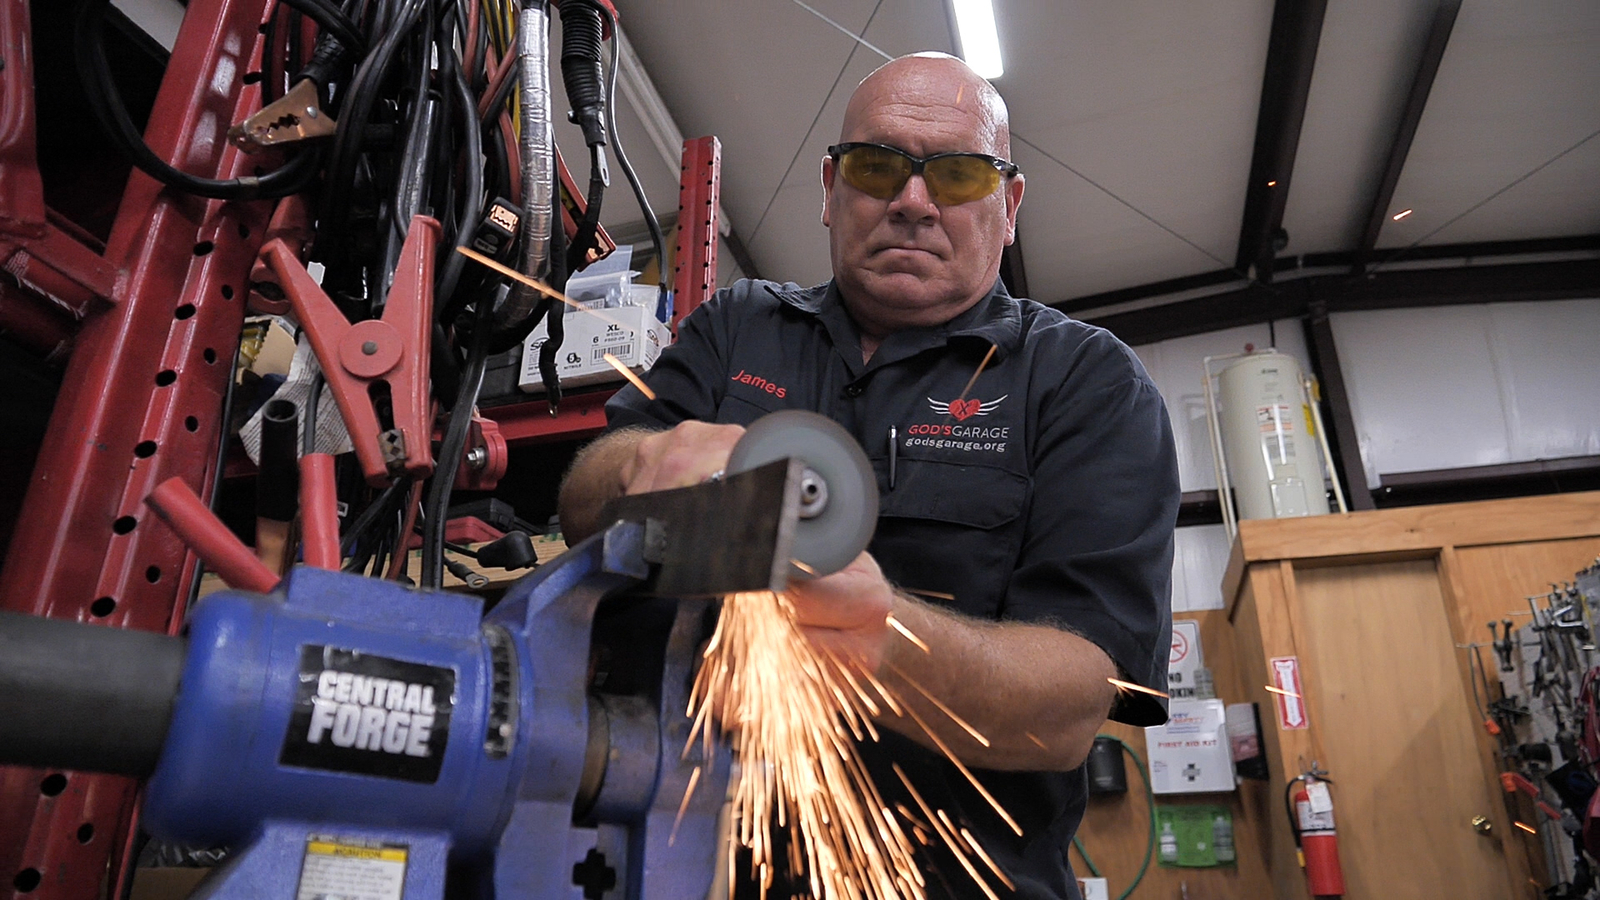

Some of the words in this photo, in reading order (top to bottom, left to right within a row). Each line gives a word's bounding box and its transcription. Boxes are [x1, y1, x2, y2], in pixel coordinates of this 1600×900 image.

[607, 324, 620, 332] XL
[731, 369, 787, 399] James
[905, 437, 1007, 453] godsgarage.org
[317, 670, 436, 715] CENTRAL
[307, 699, 435, 758] FORGE
[1202, 739, 1218, 747] KIT
